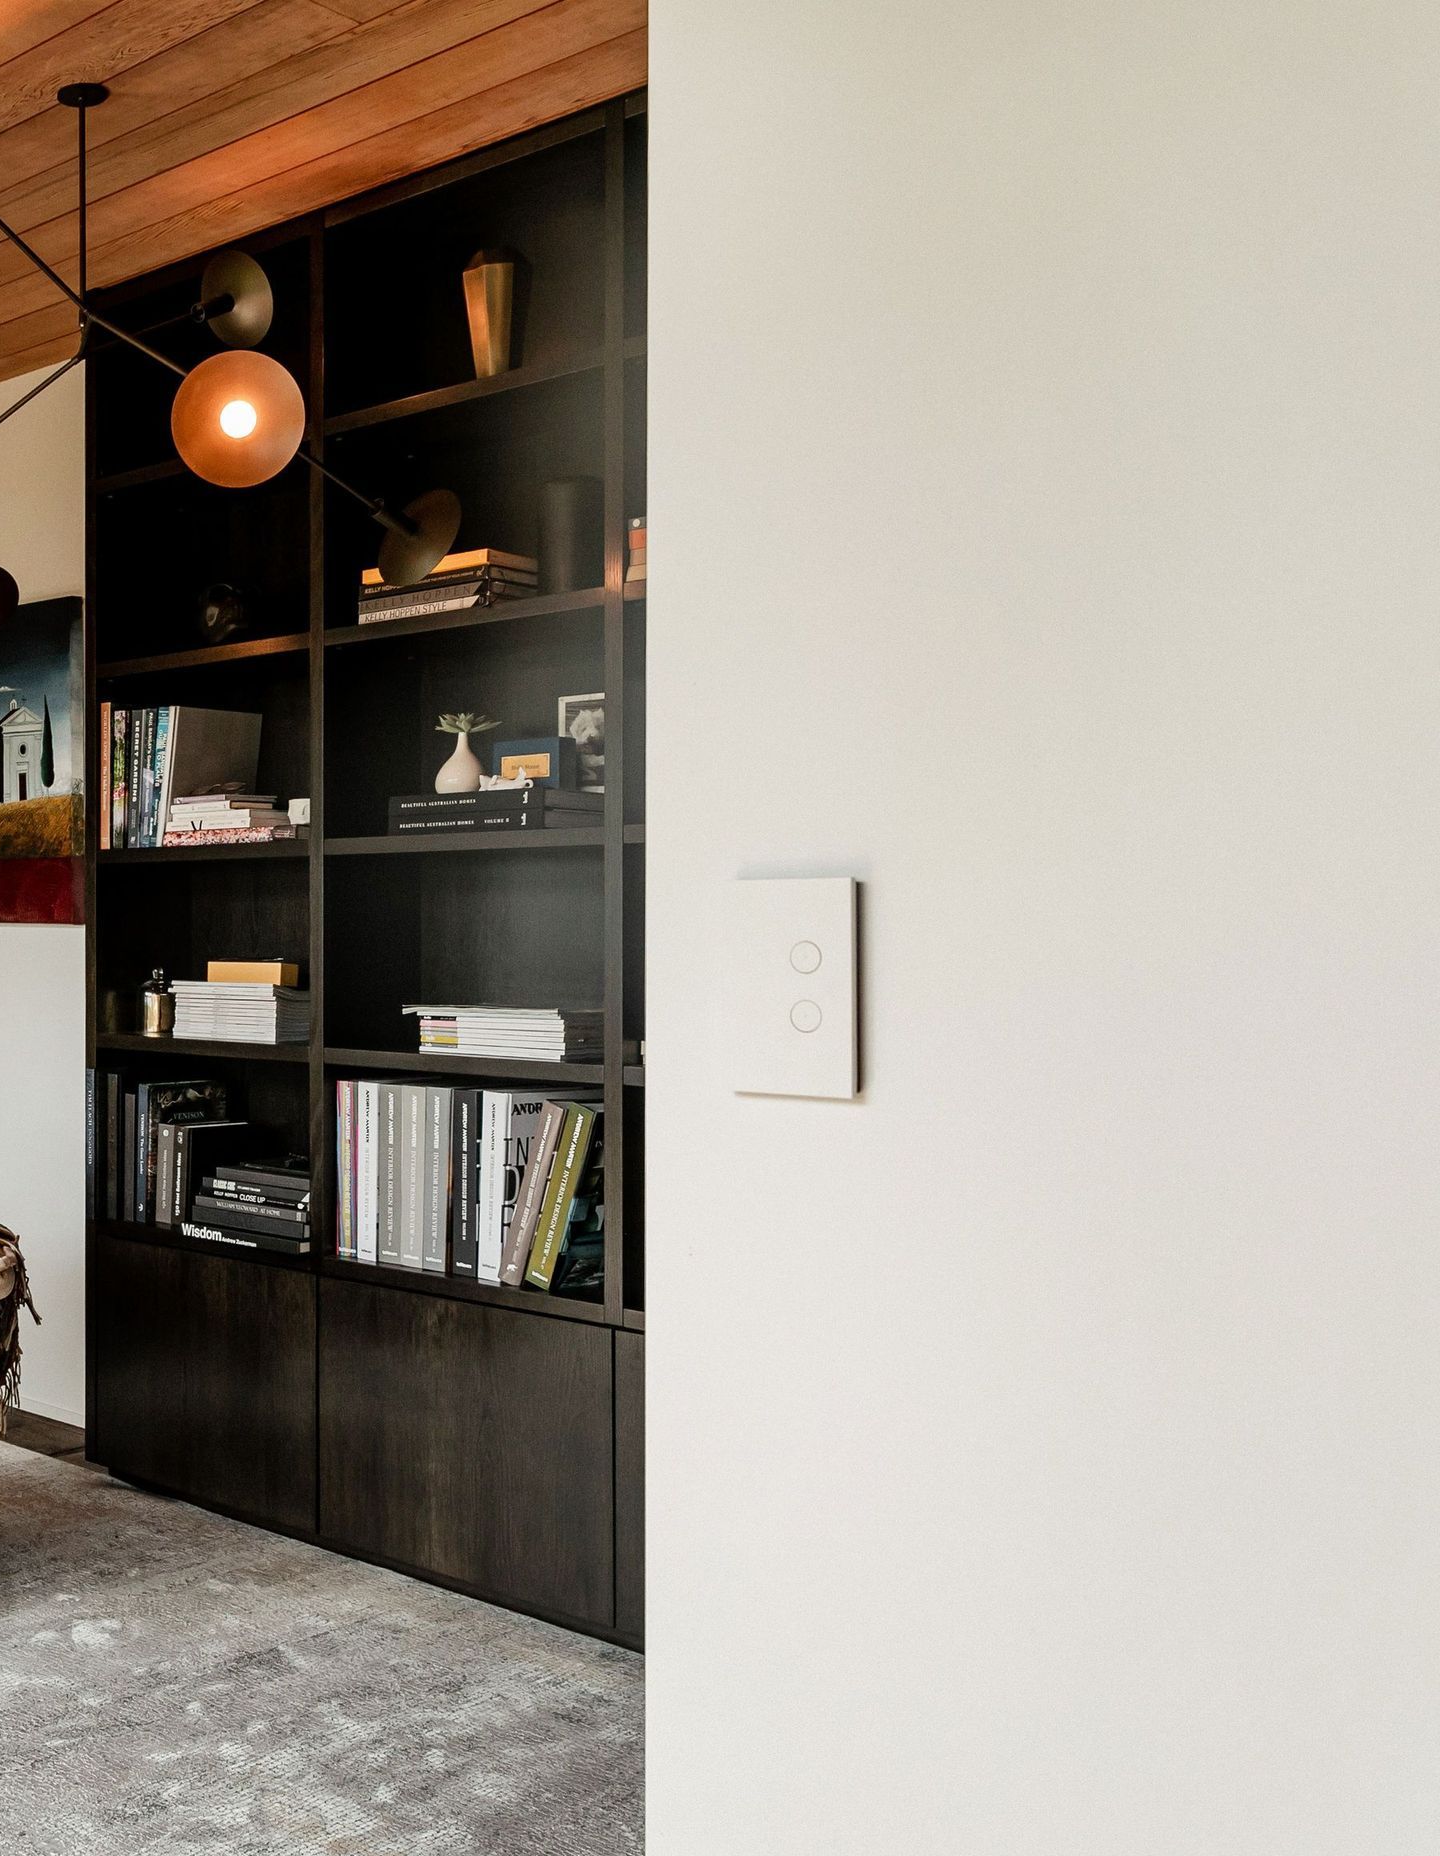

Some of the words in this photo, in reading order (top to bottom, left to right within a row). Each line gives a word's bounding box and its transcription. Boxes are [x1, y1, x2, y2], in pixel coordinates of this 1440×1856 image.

[365, 598, 404, 610] KELLY
[412, 586, 470, 602] HOPPEN
[365, 612, 386, 622] KELLY
[390, 607, 420, 618] HOPPEN
[423, 602, 447, 614] STYLE
[401, 801, 427, 809] BEAUTIFUL
[569, 1114, 584, 1144] ANDREW
[503, 1137, 535, 1167] IN
[565, 1143, 576, 1168] MARTIN
[239, 1193, 257, 1202] CLOSE
[257, 1195, 266, 1204] UP
[555, 1170, 570, 1204] INTERIOR
[549, 1204, 563, 1230] DESIGN
[181, 1223, 222, 1242] Wisdom
[543, 1231, 555, 1256] REVIEW
